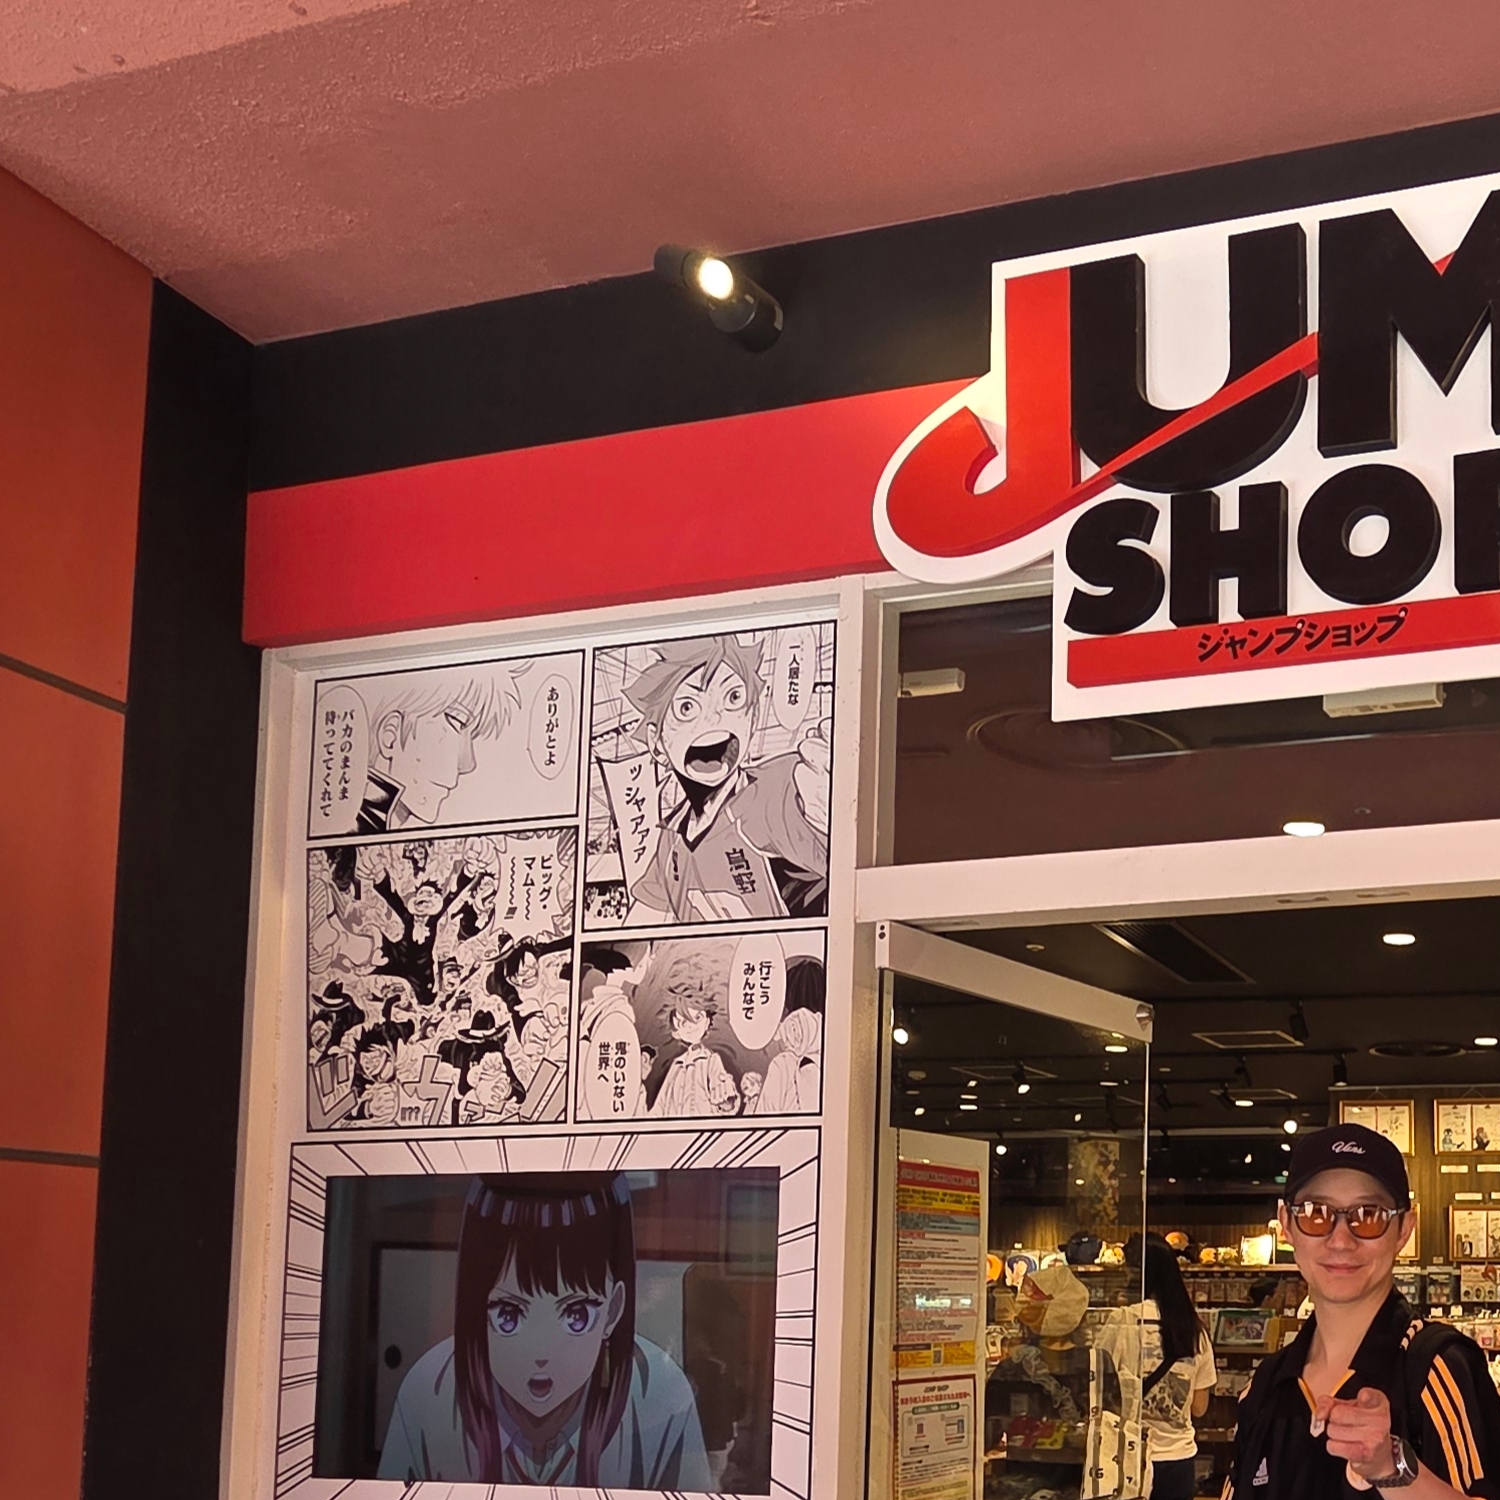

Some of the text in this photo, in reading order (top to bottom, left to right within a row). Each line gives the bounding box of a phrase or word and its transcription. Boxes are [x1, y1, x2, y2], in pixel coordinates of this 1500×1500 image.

[1197, 606, 1409, 663] ジャンプショップ
[338, 709, 355, 800] バカのまんま
[544, 686, 560, 767] ありがとよ
[742, 963, 756, 1021] みんなで
[758, 961, 773, 1006] 行こう
